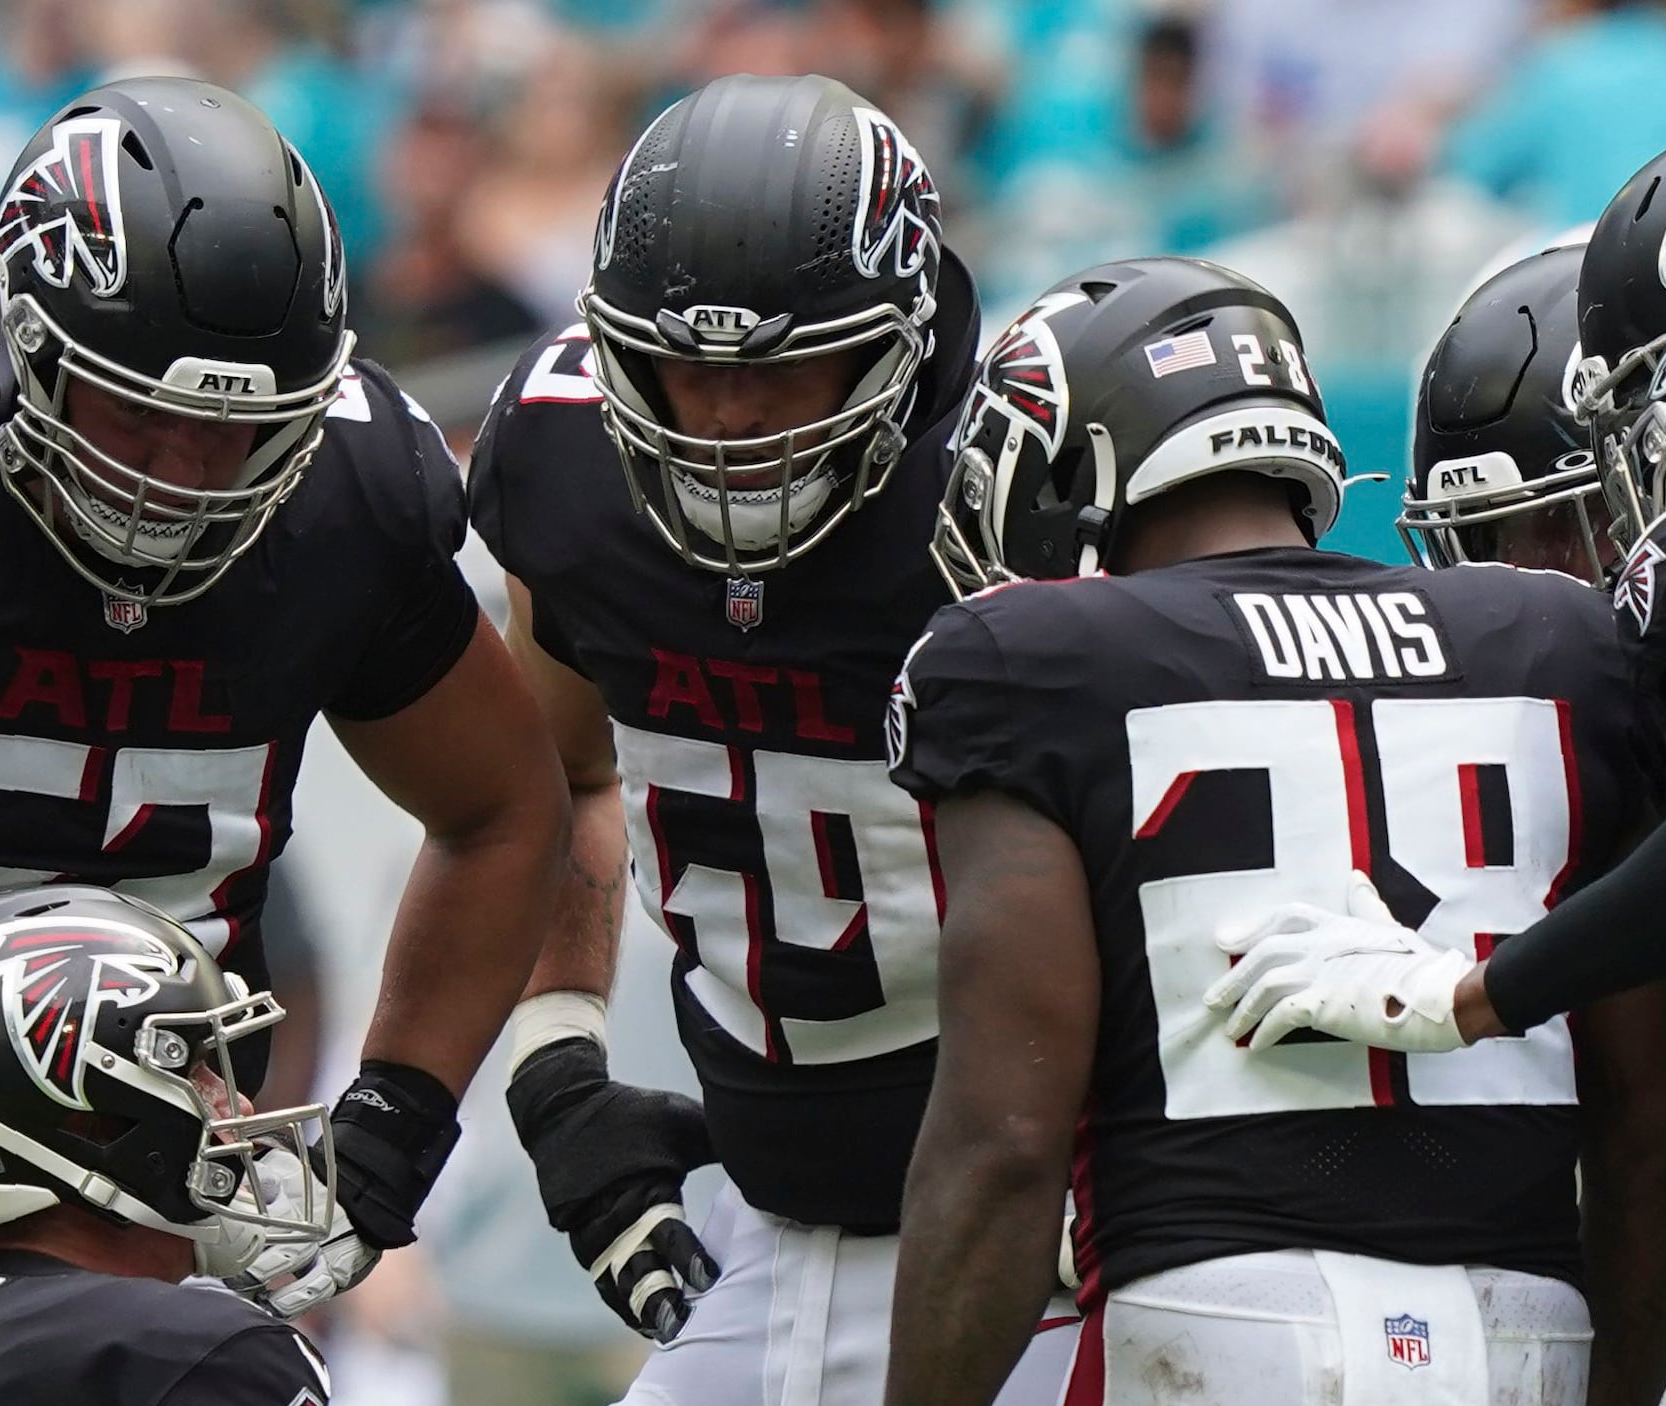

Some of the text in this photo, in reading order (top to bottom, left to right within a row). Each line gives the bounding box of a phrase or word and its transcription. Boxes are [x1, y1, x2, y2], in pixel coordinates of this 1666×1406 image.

[691, 309, 753, 331] ATL
[1230, 334, 1316, 397] 28
[197, 371, 257, 394] ATL
[1440, 466, 1486, 489] ATL
[110, 602, 142, 624] NFL
[732, 600, 757, 621] NFL
[1232, 591, 1447, 681] DAVIS
[646, 646, 857, 745] ATL
[606, 714, 949, 1067] 69
[1125, 696, 1583, 1121] 28
[1390, 1336, 1429, 1363] NFL
